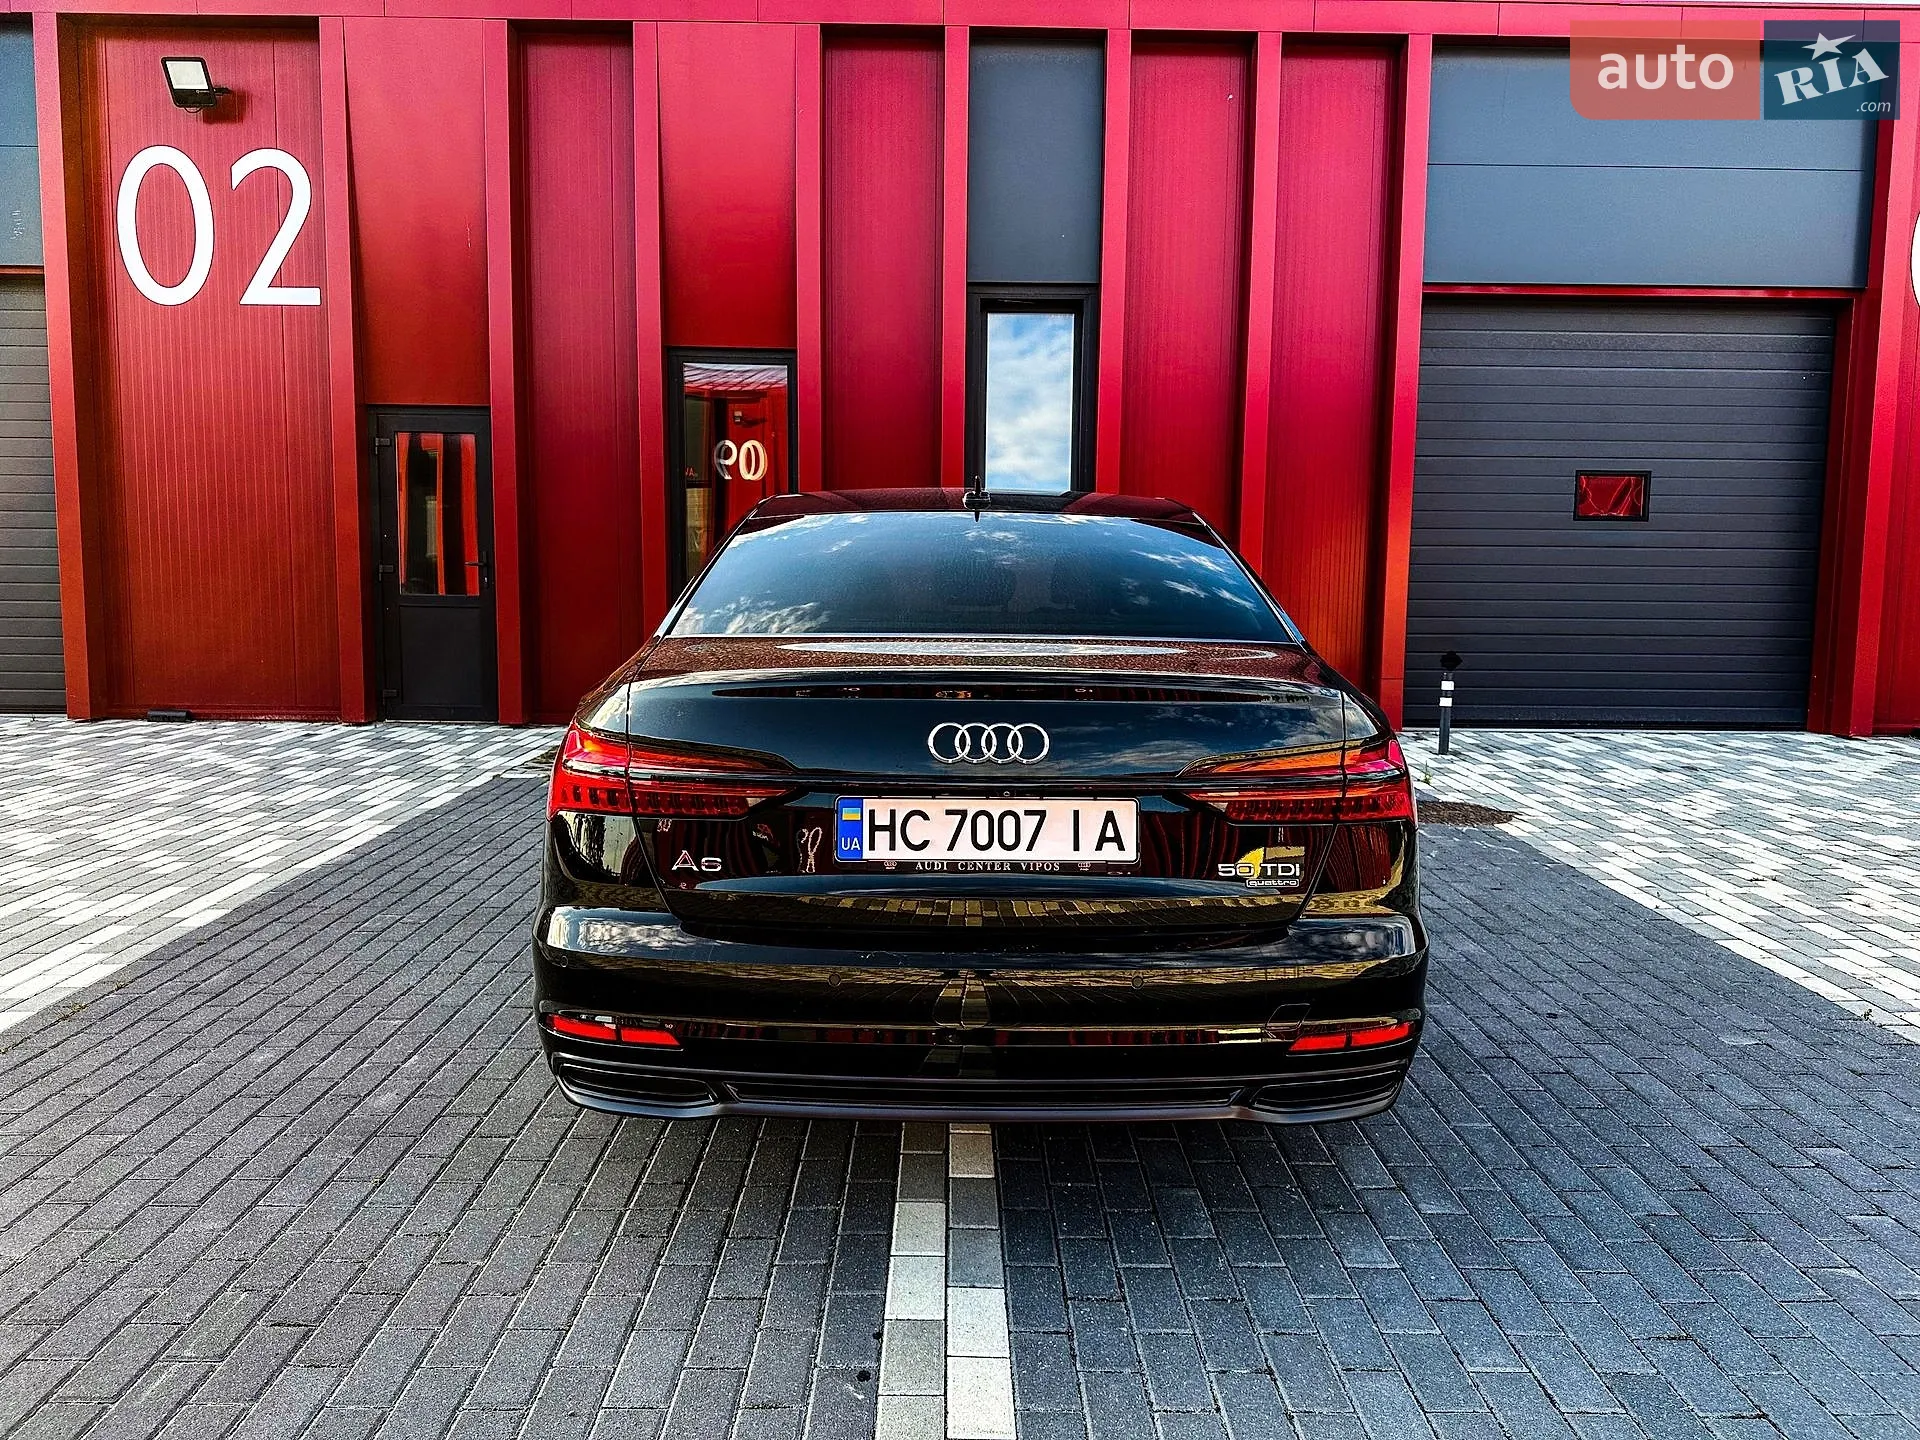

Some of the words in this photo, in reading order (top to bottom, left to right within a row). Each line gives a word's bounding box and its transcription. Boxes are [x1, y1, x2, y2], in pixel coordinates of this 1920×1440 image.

[116, 144, 322, 306] 02
[868, 809, 930, 851] HC
[945, 809, 1047, 851] 7007
[841, 837, 861, 851] UA
[671, 850, 722, 872] A6
[915, 861, 948, 871] AUDI
[957, 861, 1011, 871] CENTER
[1021, 861, 1060, 871] VIPOS
[1217, 863, 1255, 877] 50
[1260, 863, 1300, 877] TDI
